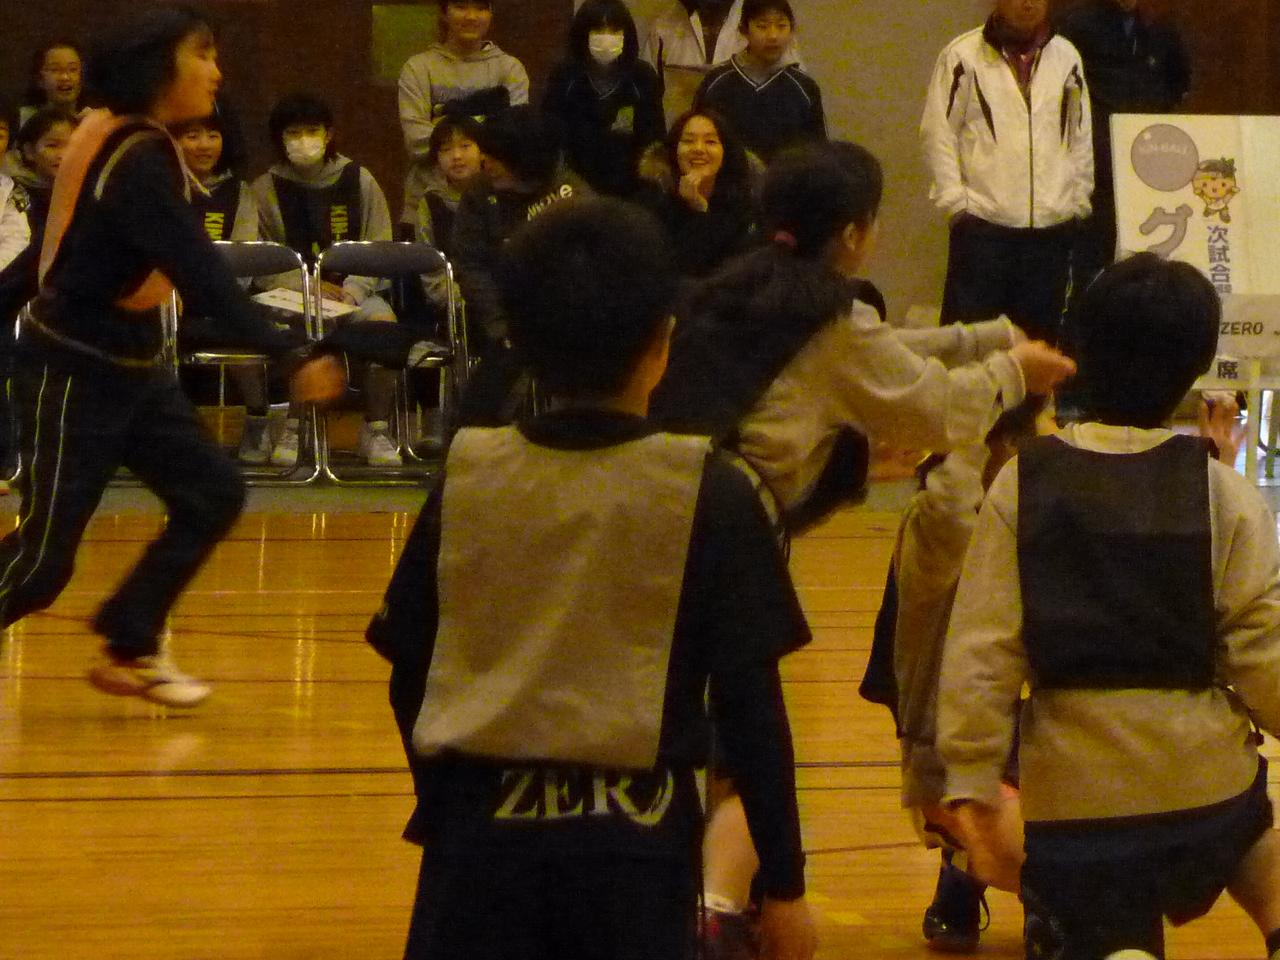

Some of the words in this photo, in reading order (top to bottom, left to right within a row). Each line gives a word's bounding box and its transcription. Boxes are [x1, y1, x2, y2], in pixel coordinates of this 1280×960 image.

[1220, 321, 1264, 336] ZERO
[1217, 360, 1239, 380] 席
[493, 767, 675, 826] ZERO
